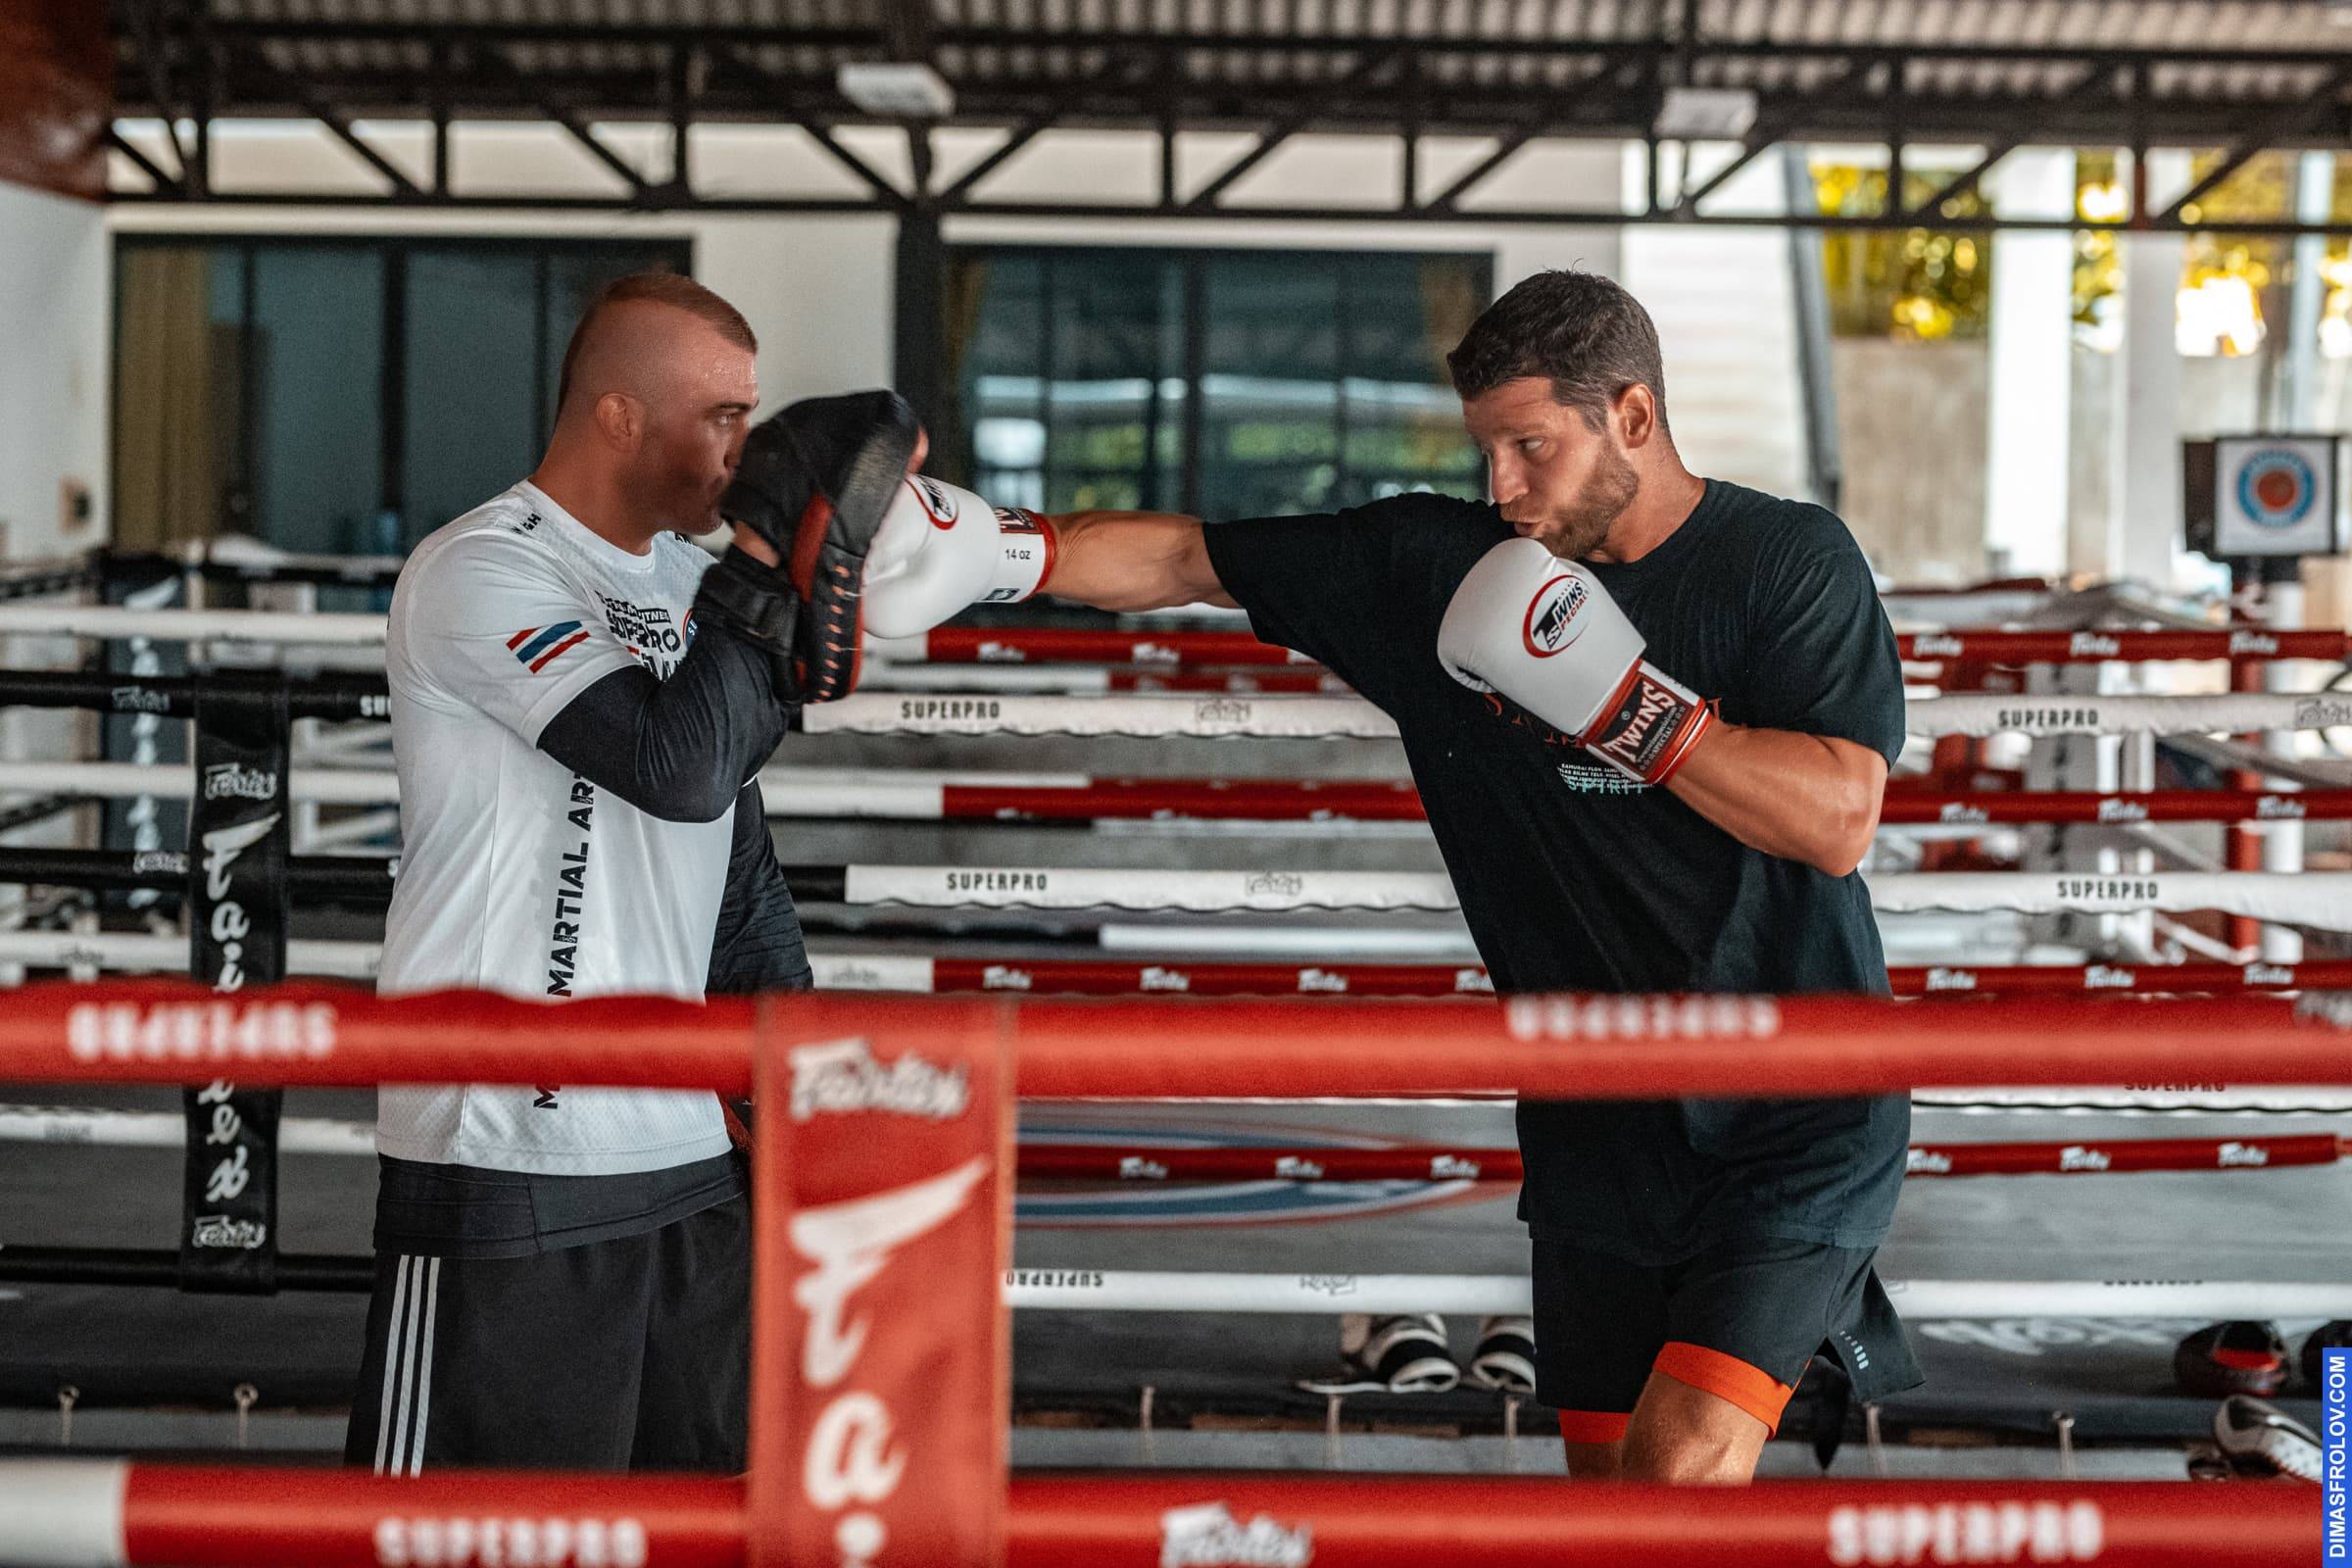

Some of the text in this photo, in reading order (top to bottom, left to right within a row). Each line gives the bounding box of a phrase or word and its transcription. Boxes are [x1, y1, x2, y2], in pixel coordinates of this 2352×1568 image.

[1005, 548, 1017, 561] 14
[1533, 582, 1584, 639] TWINS
[901, 701, 1001, 719] SUPERPRO
[1998, 710, 2098, 727] SUPERPRO
[1601, 680, 1676, 762] TWINS
[947, 872, 1048, 891] SUPERPRO
[2058, 880, 2158, 899] SUPERPRO
[547, 842, 589, 998] MARTIAL
